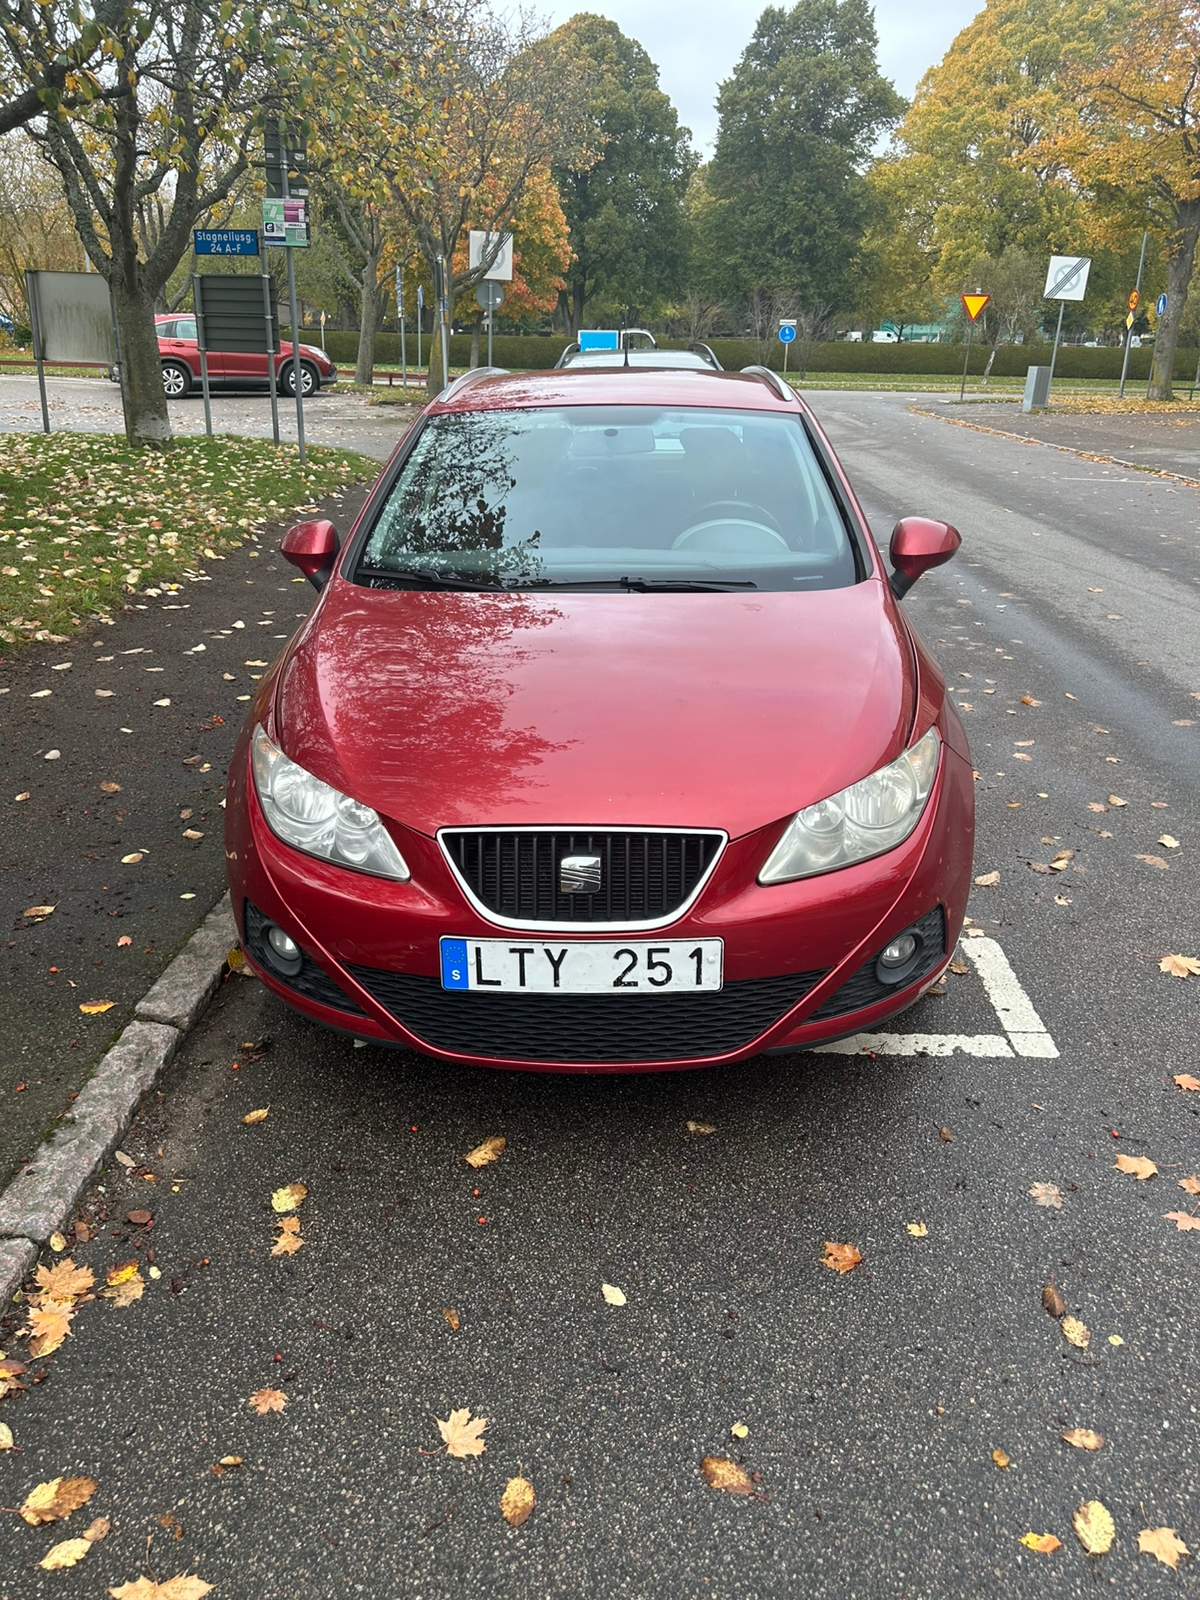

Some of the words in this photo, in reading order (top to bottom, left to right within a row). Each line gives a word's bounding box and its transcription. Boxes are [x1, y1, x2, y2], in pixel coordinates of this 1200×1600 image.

[196, 231, 254, 244] Stagneliusg.
[210, 243, 222, 253] 24
[225, 243, 242, 253] A-F
[475, 946, 569, 987] LTY
[613, 947, 703, 987] 251
[451, 969, 461, 981] S
